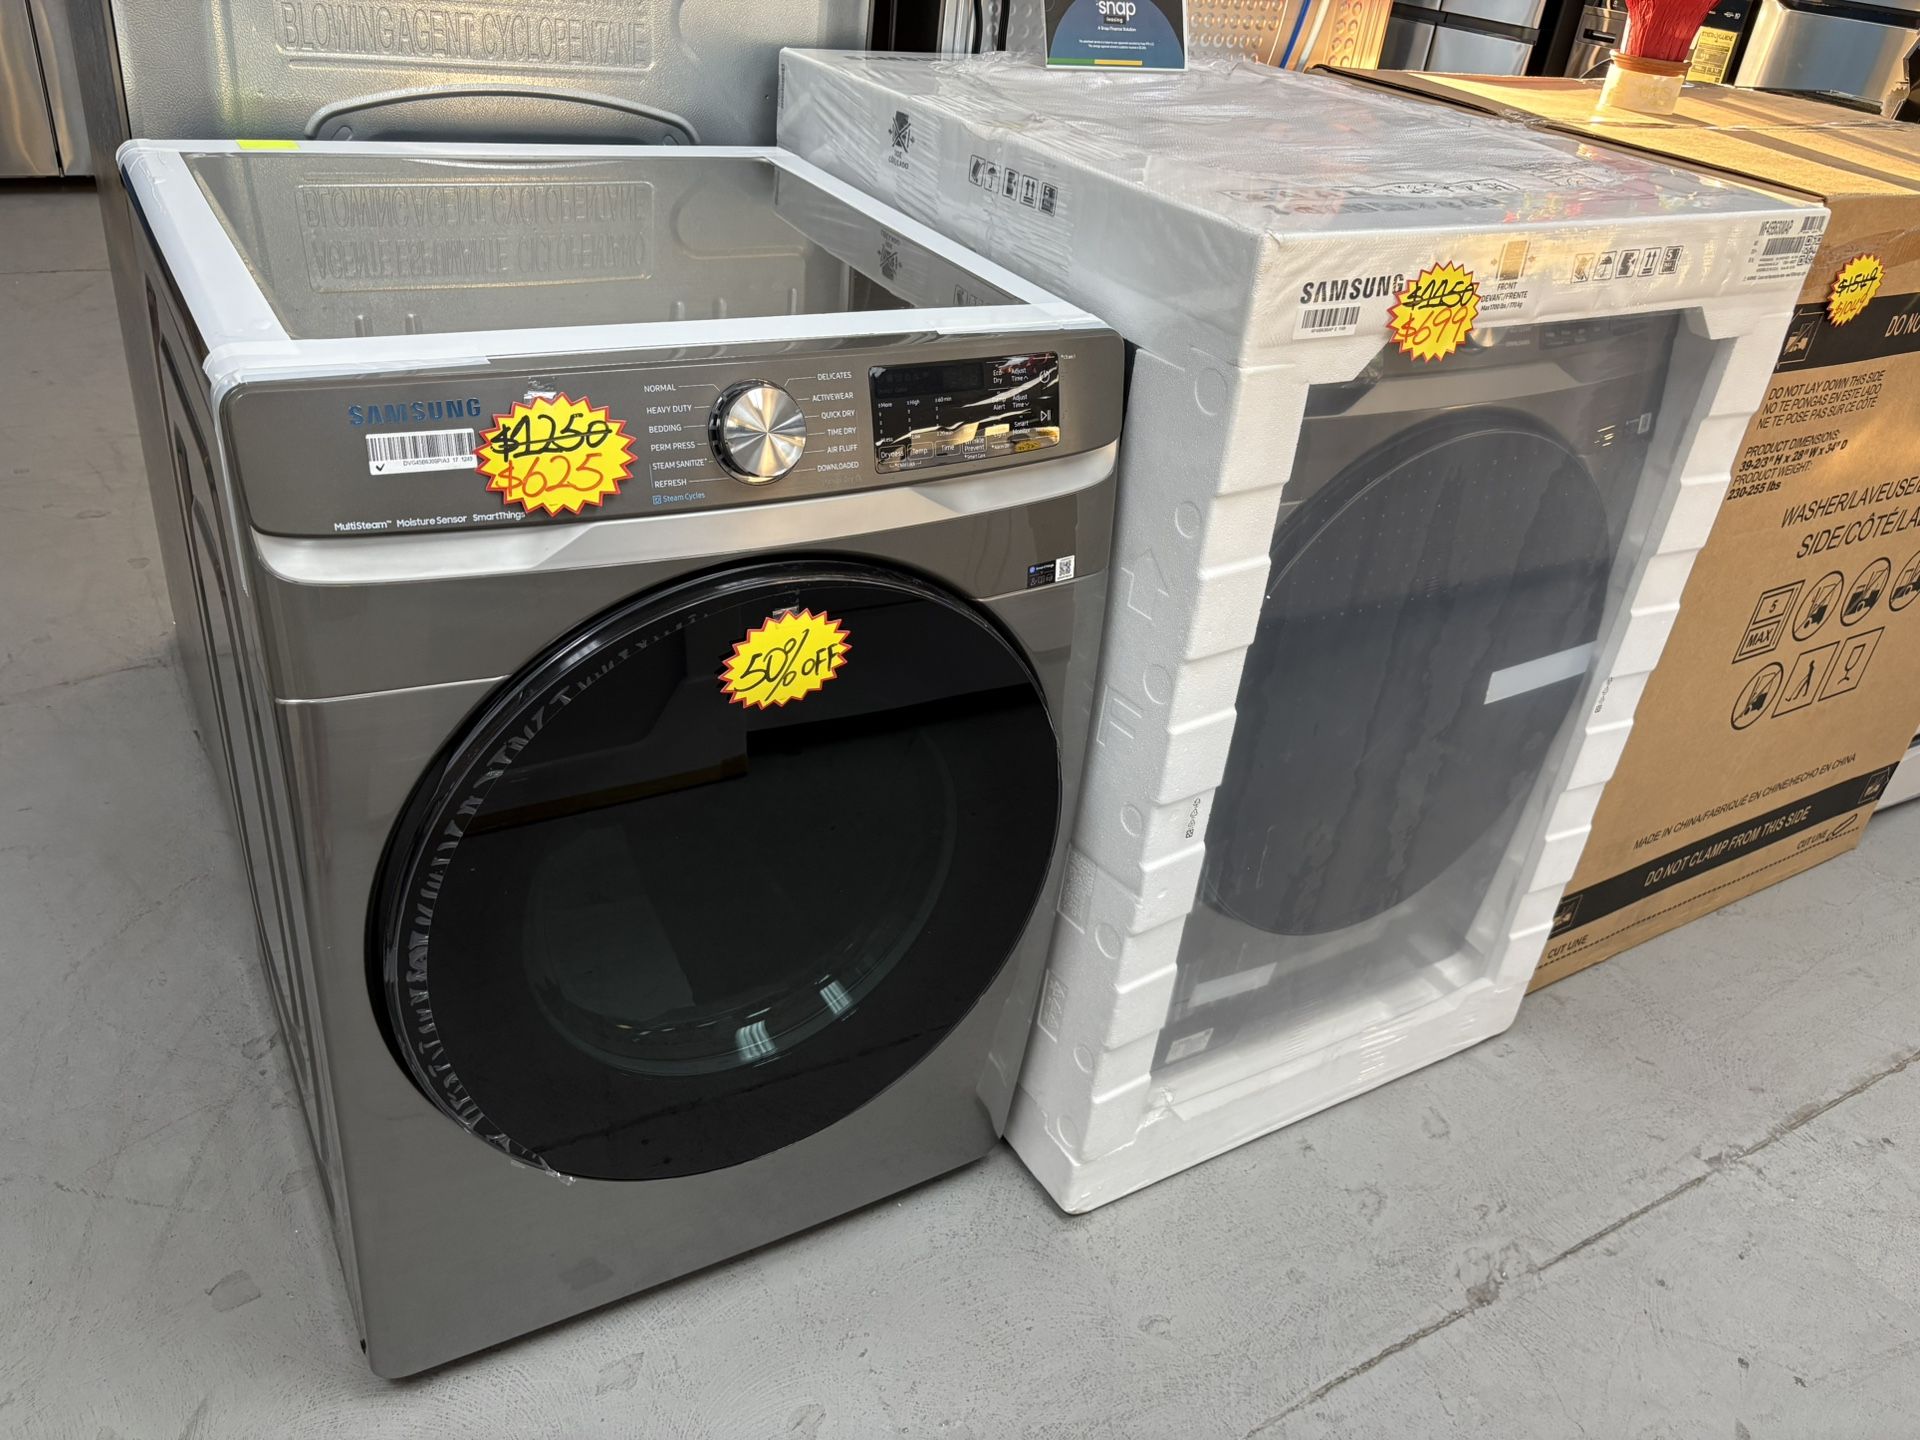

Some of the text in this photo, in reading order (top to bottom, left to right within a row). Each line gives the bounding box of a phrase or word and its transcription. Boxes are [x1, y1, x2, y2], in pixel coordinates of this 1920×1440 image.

[1098, 0, 1136, 21] snap
[284, 4, 646, 66] BLOWING AGENT CYCLOPENTANE
[1300, 273, 1405, 304] SAMSUNG
[1497, 281, 1518, 291] FRONT
[1394, 306, 1469, 346] $699
[1884, 313, 1907, 338] DO
[817, 372, 852, 381] DELICATES
[1769, 370, 1886, 400] DO NOT LAY DOWN THIS SIDE
[644, 383, 676, 392] NORMAL
[812, 392, 854, 402] ACTIVEWEAR
[646, 404, 692, 415] HEAVY DUTY
[1762, 383, 1882, 416] NO TE PONGAS EN ESTE LADO
[348, 397, 481, 427] SAMSUNG
[821, 410, 856, 420] QUICK DRY
[1756, 416, 1771, 430] NE
[1772, 414, 1784, 427] TE
[1784, 410, 1810, 425] POSE
[1810, 406, 1829, 420] PAS
[1827, 404, 1846, 418] SUR
[1844, 401, 1856, 413] CE
[490, 412, 613, 463] $1250
[648, 424, 682, 434] BEDDING
[827, 427, 857, 436] TIME DRY
[650, 441, 696, 452] PERM PRESS
[826, 444, 858, 454] AIR FLUFF
[1744, 428, 1841, 459] PRODUCT DIMENSIONS:
[1774, 454, 1784, 466] H
[1784, 454, 1790, 464] x
[1808, 446, 1820, 458] W
[1840, 439, 1848, 450] D
[880, 450, 904, 460] Dryness
[496, 452, 604, 498] $625
[652, 462, 675, 470] STEAM
[816, 460, 860, 472] DOWNLOADED
[1732, 460, 1813, 486] PRODUCT WEIGHT:
[654, 478, 687, 488] REFRESH
[1726, 480, 1782, 500] 230-255 lbs
[662, 492, 706, 504] Steam Cycles
[396, 518, 435, 528] Moisture
[436, 514, 468, 524] Sensor
[472, 511, 526, 522] SmartThings
[1796, 505, 1920, 559] SIDE/CÔTÉ/LA
[1769, 600, 1779, 613] 5
[1746, 628, 1774, 649] MAX
[734, 628, 810, 702] 50%
[1634, 830, 1662, 850] MADE
[1661, 826, 1672, 839] IN
[1748, 790, 1762, 803] EN
[1818, 764, 1832, 776] EN
[1830, 752, 1856, 772] CHINA
[1644, 804, 1812, 888] DO NOT CLAMP FROM THIS SIDE
[1797, 828, 1830, 850] CUT LINE
[1548, 934, 1589, 959] CUT LINE
